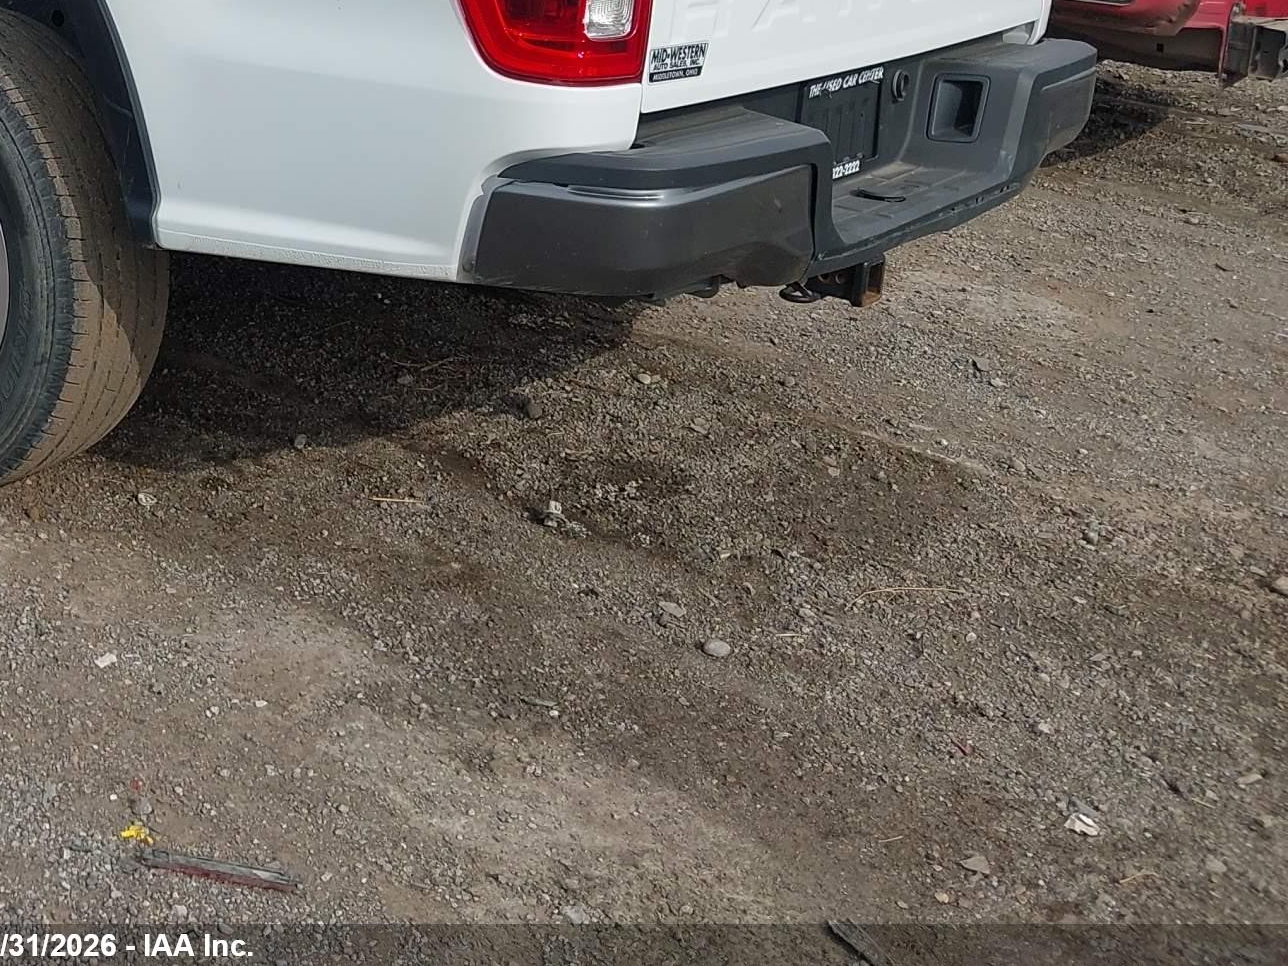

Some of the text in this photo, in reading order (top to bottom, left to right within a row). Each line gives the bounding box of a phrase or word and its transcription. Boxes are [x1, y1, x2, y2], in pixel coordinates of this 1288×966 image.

[653, 62, 669, 71] AUTO
[809, 84, 822, 99] THE
[843, 73, 859, 88] CAR
[858, 66, 884, 84] CENTER
